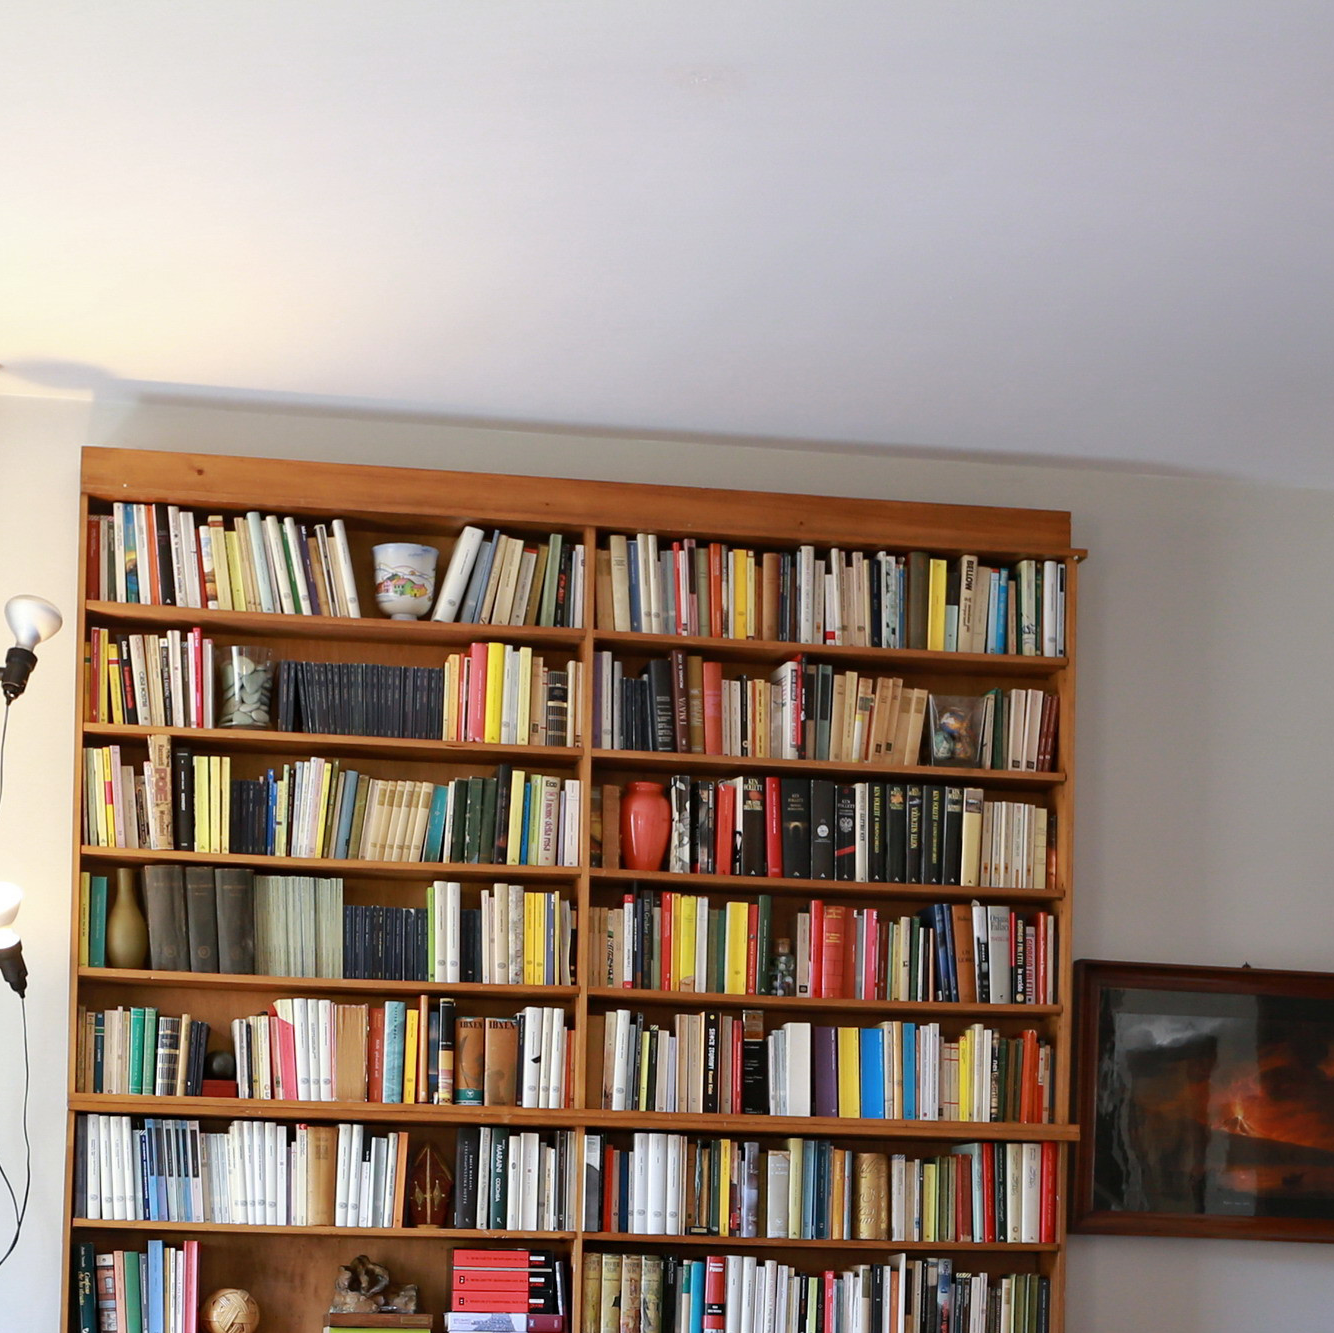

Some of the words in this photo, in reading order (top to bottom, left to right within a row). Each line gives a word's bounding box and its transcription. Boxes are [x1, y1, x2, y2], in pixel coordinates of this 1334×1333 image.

[965, 560, 974, 591] BELLOW
[679, 698, 687, 720] MAYA
[155, 767, 167, 801] POE
[743, 783, 763, 791] FOLLETT
[544, 803, 555, 819] nome
[544, 821, 555, 837] della
[543, 838, 552, 852] rosa
[1027, 939, 1035, 967] GIORGIO
[1027, 969, 1035, 997] FALETTI
[708, 1028, 716, 1045] SHOCK
